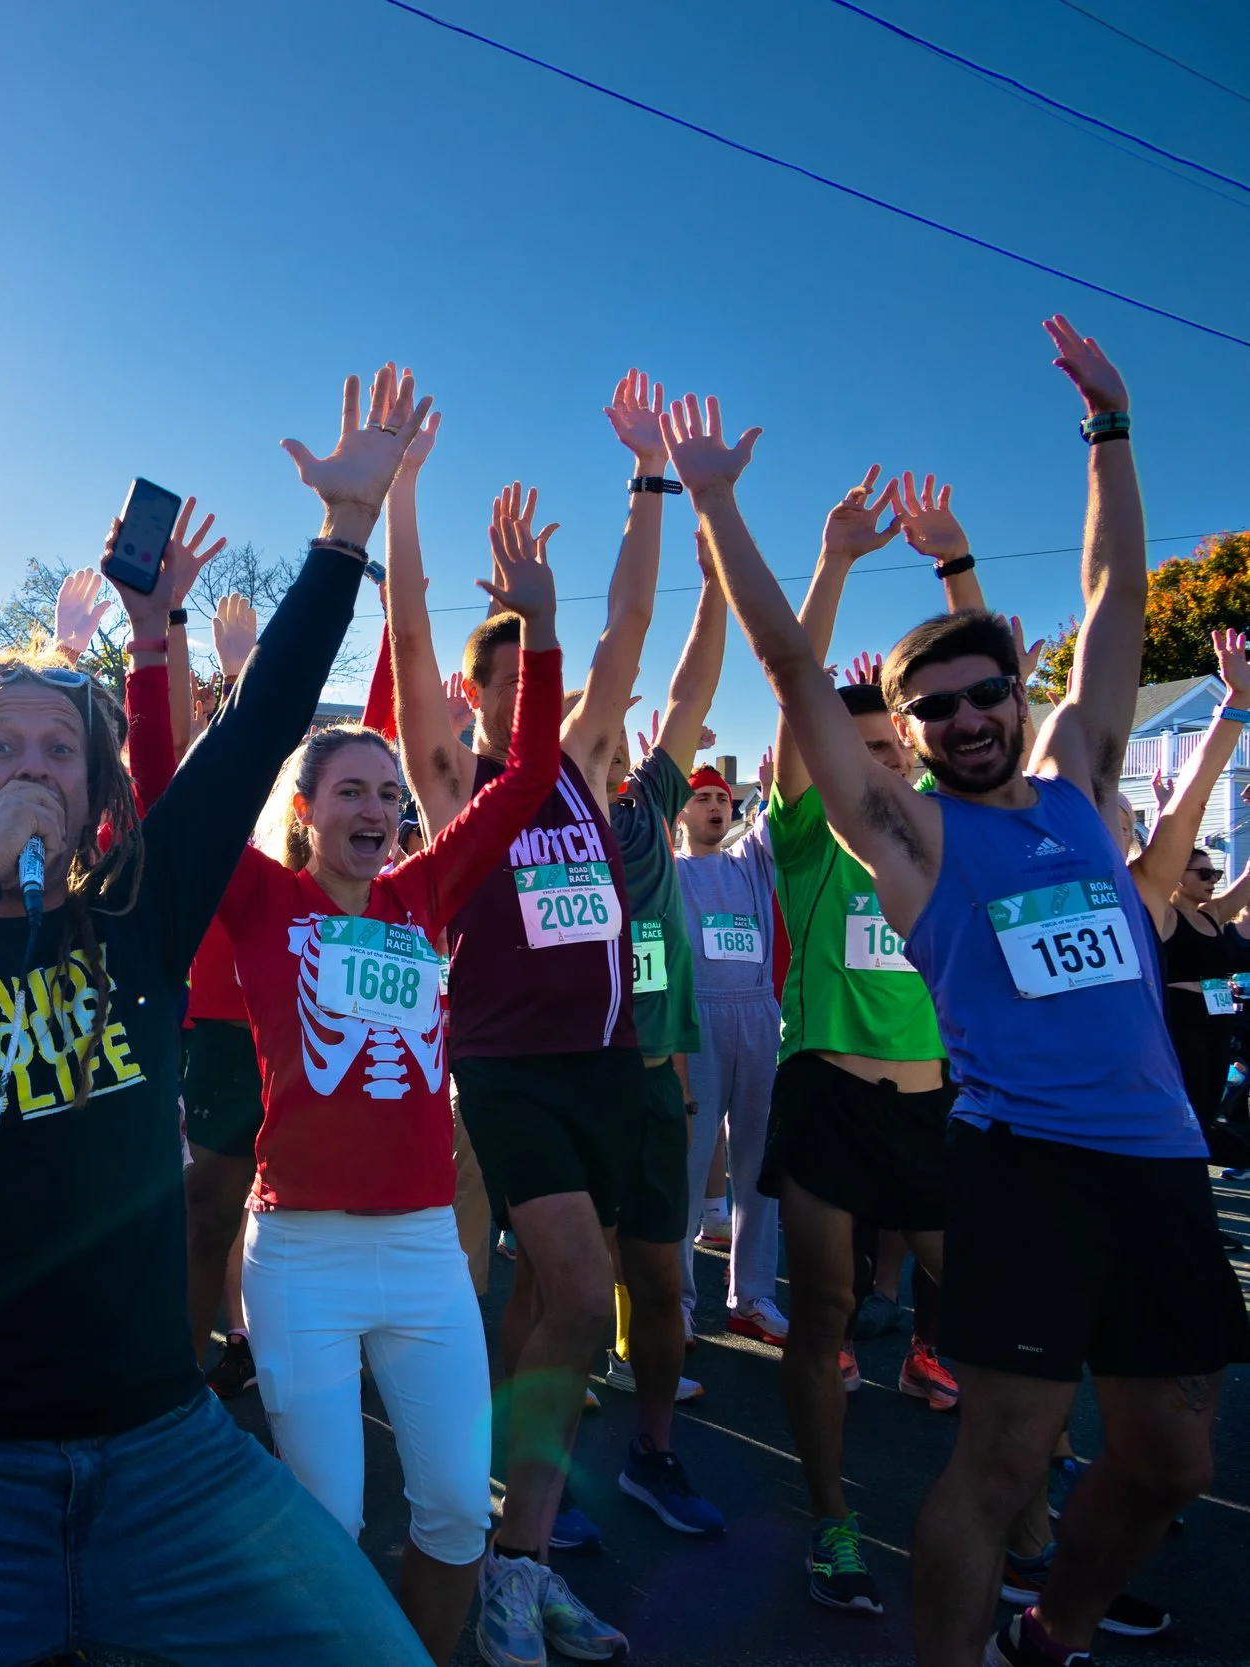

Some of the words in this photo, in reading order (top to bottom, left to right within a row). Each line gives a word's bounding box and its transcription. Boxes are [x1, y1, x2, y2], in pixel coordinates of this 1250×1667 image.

[510, 822, 607, 867] NOTCH
[1035, 845, 1066, 857] adidas
[568, 874, 591, 883] RACE
[1091, 892, 1118, 905] RACE
[537, 893, 608, 930] 2026
[642, 922, 661, 930] ROAD
[642, 929, 662, 939] RACE
[389, 929, 412, 941] ROAD
[713, 931, 754, 952] 1683
[385, 938, 412, 953] RACE
[1031, 924, 1125, 977] 1531
[350, 947, 366, 956] YMCA
[374, 951, 383, 959] the
[384, 953, 400, 962] North
[400, 957, 417, 966] Shore
[341, 955, 421, 1009] 1688
[13, 1022, 141, 1113] LIFE
